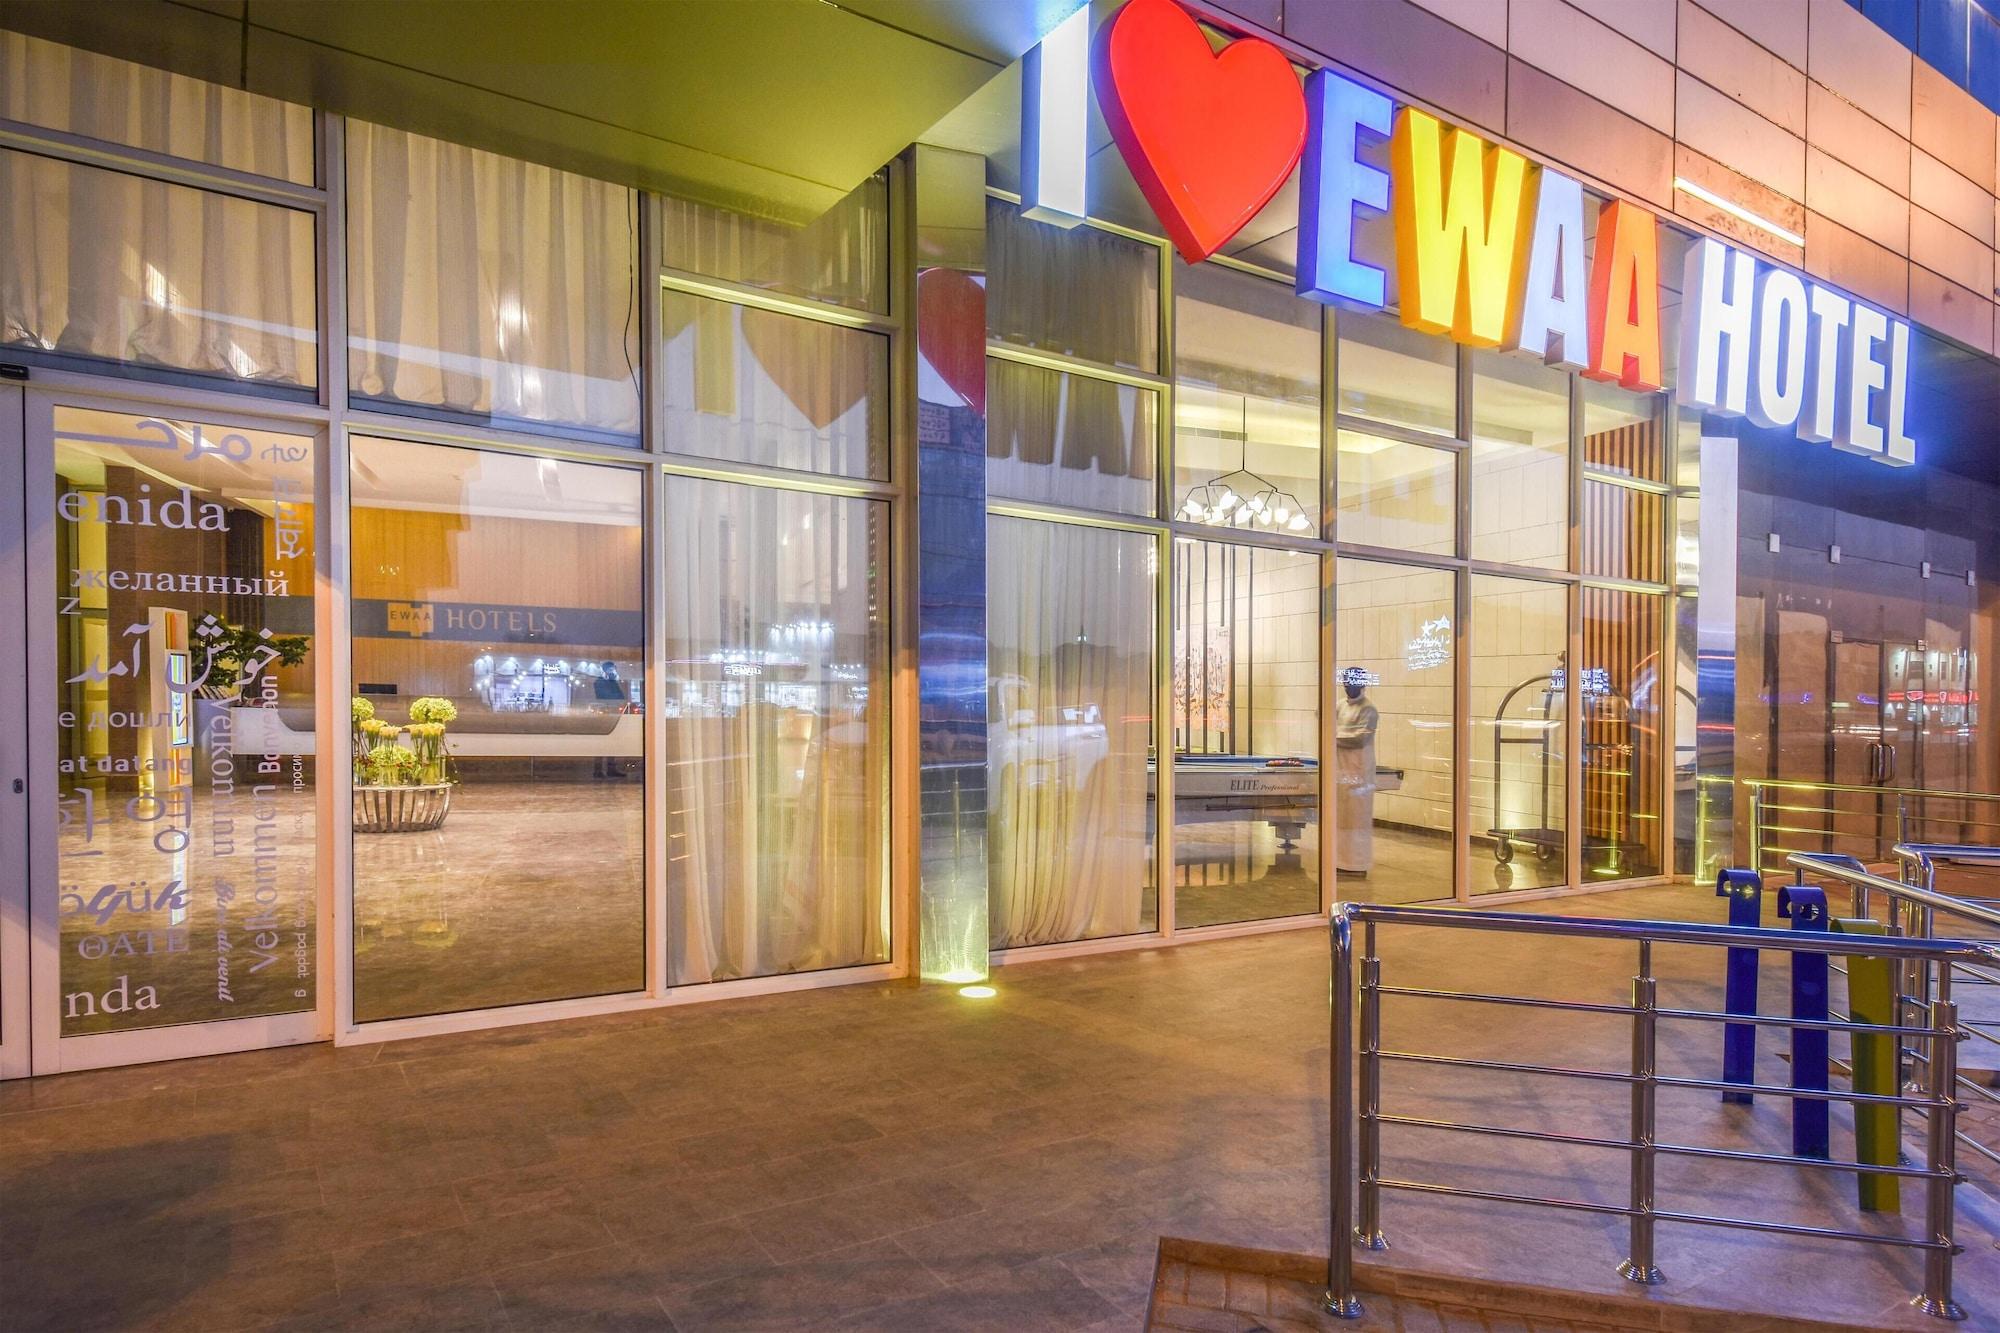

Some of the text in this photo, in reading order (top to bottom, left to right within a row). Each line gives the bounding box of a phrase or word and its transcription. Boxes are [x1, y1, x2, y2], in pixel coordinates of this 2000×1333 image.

[1021, 4, 1917, 467] I EWAA HOTEL
[57, 483, 230, 533] enida
[70, 569, 290, 598] желанный
[390, 608, 557, 633] EWAA HOTELS
[87, 711, 192, 732] дошли
[97, 755, 192, 775] datang
[1230, 779, 1260, 791] ELITE
[246, 784, 279, 974] Velkommen
[295, 931, 310, 998] pagdatg
[64, 975, 161, 1019] nda
